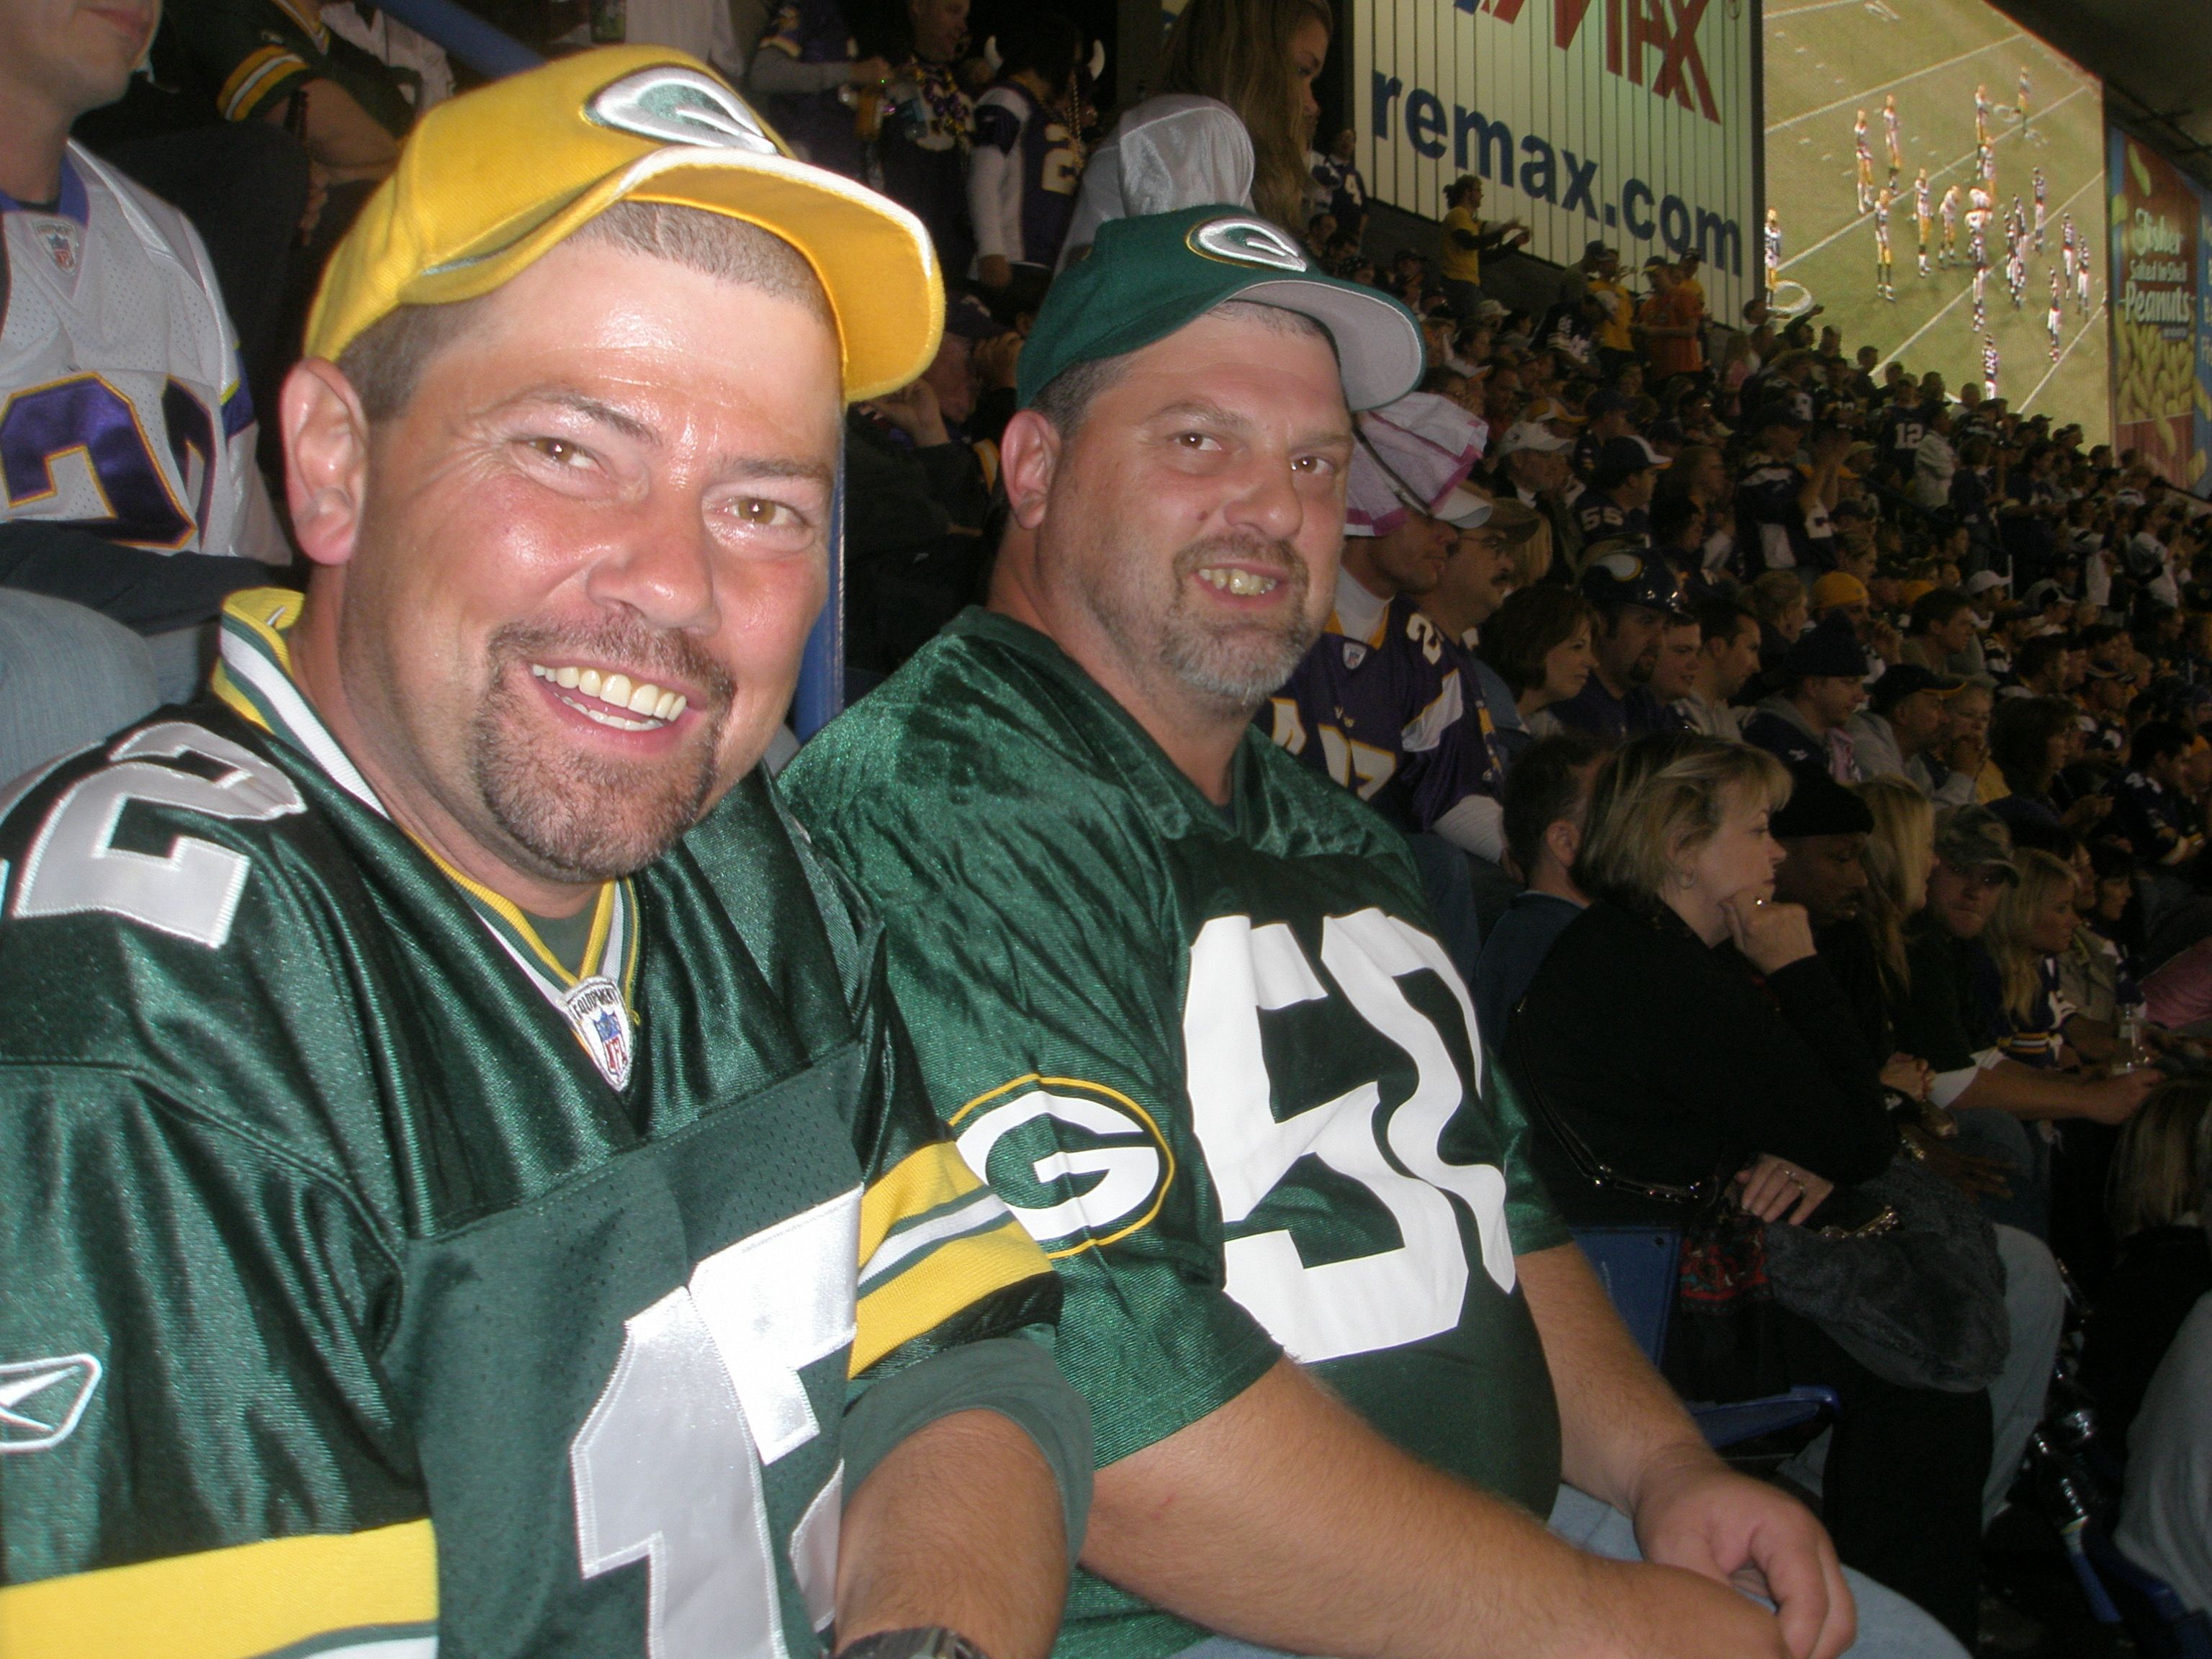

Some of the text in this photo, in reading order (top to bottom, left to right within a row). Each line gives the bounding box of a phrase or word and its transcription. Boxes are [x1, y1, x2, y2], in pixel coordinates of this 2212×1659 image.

[1371, 69, 1743, 278] remax.com
[2126, 280, 2190, 323] Peanuts
[0, 721, 308, 950] 2
